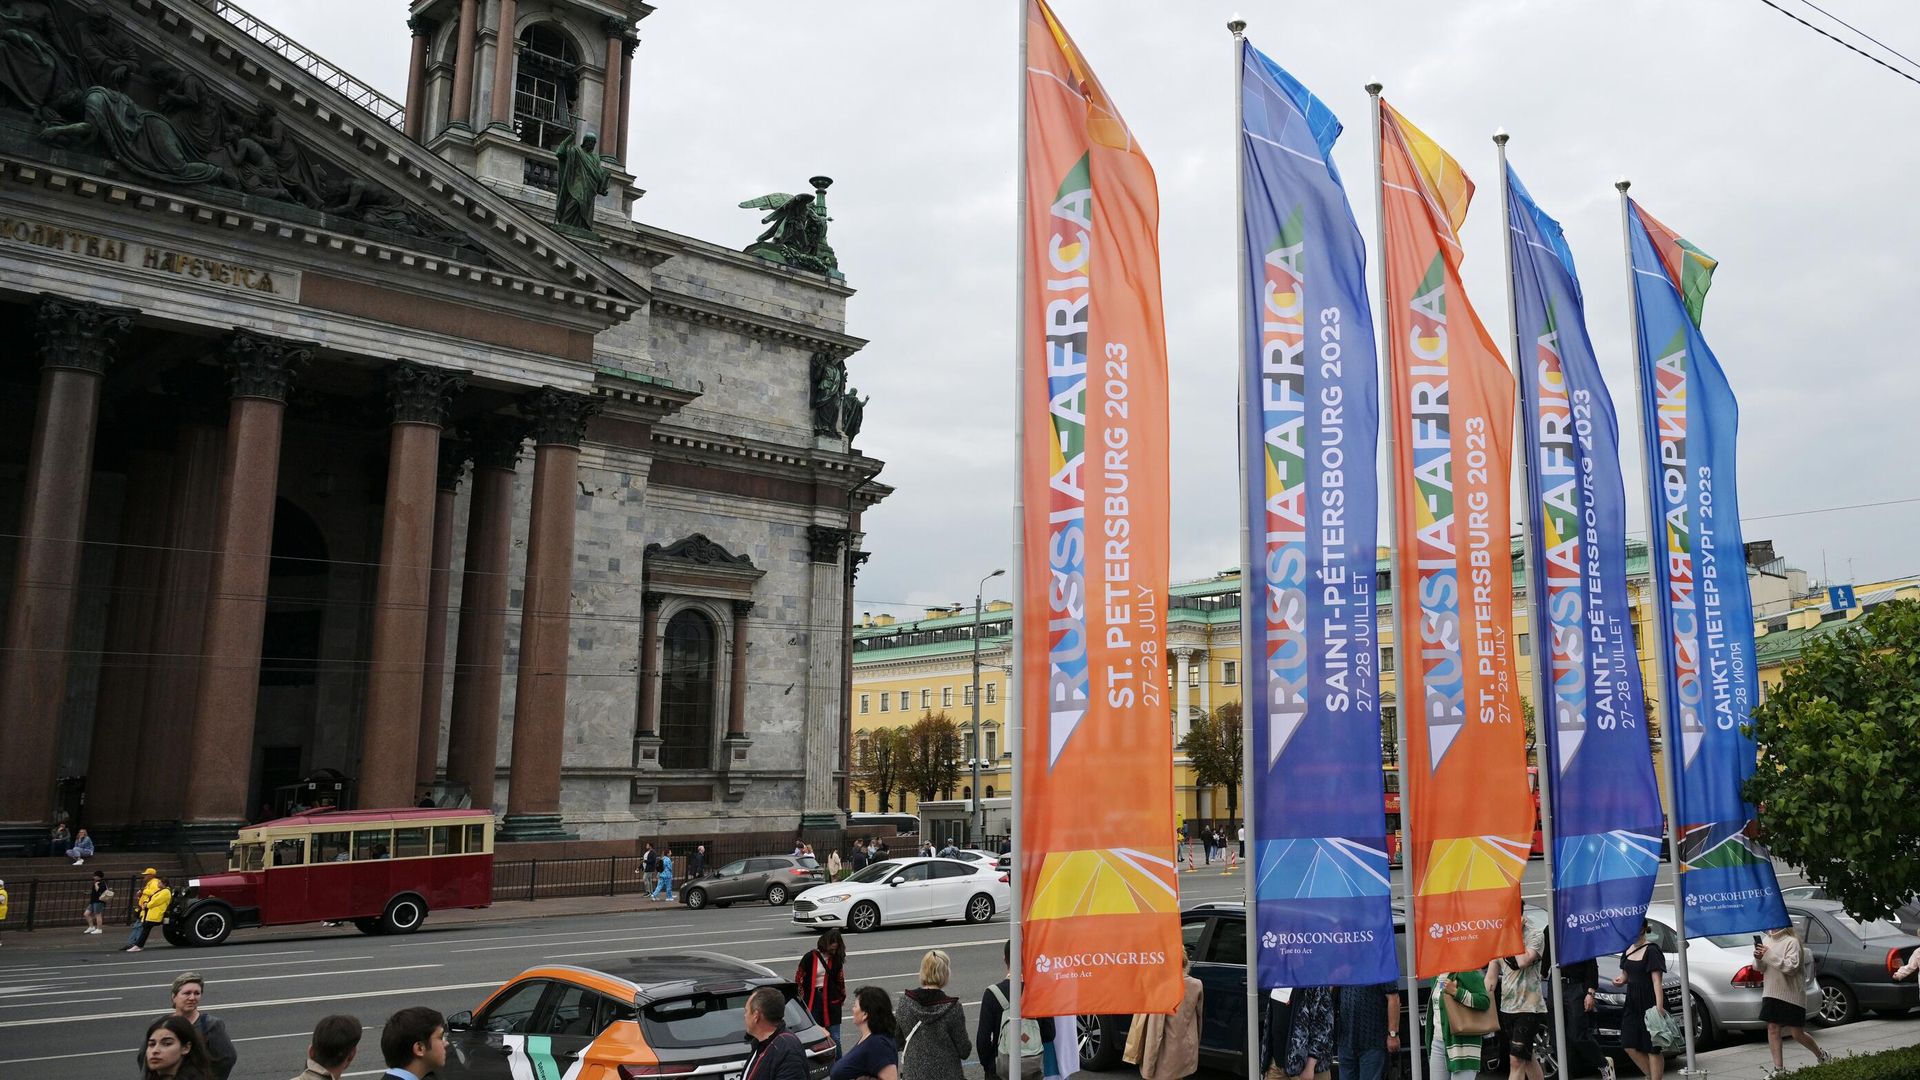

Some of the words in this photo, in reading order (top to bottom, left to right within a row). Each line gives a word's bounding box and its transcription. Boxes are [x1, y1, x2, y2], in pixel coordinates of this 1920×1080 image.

[1320, 306, 1342, 379] 2023
[1104, 342, 1129, 419] 2023
[1046, 188, 1091, 713] RUSSIA-AFRICA
[1466, 416, 1488, 485] 2023
[1573, 389, 1593, 451] 2023
[1263, 241, 1307, 714] RUSSIA-AFRICA
[1409, 283, 1464, 726] RUSSIA-AFRICA
[1698, 466, 1714, 519] 2023
[1104, 427, 1132, 649] PETERSBURG
[1316, 386, 1349, 713] SAINT-PÉTERSBOURG
[1538, 329, 1586, 732] RUSSIA-AFRICA
[1656, 349, 1705, 733] РОССИЯ-АФРИКА
[1137, 584, 1156, 633] JULY
[1352, 572, 1370, 647] JUILLET
[1468, 491, 1495, 677] PETERSBURG
[1581, 457, 1616, 730] SAINT-PÉTERSBOURG
[1496, 625, 1507, 666] JULY
[1609, 615, 1628, 677] JUILLET
[1700, 523, 1734, 731] САНКТ-ПЕТЕРБУРГ
[1107, 658, 1135, 709] ST.
[1730, 642, 1747, 684] ИЮЛЯ
[1479, 683, 1496, 724] ST.
[1445, 919, 1506, 935] ROSCONG
[1698, 887, 1773, 903] РОСКОНГРЕСС
[1053, 951, 1165, 969] ROSCONGRESS
[1279, 930, 1374, 945] ROSCONGRESS
